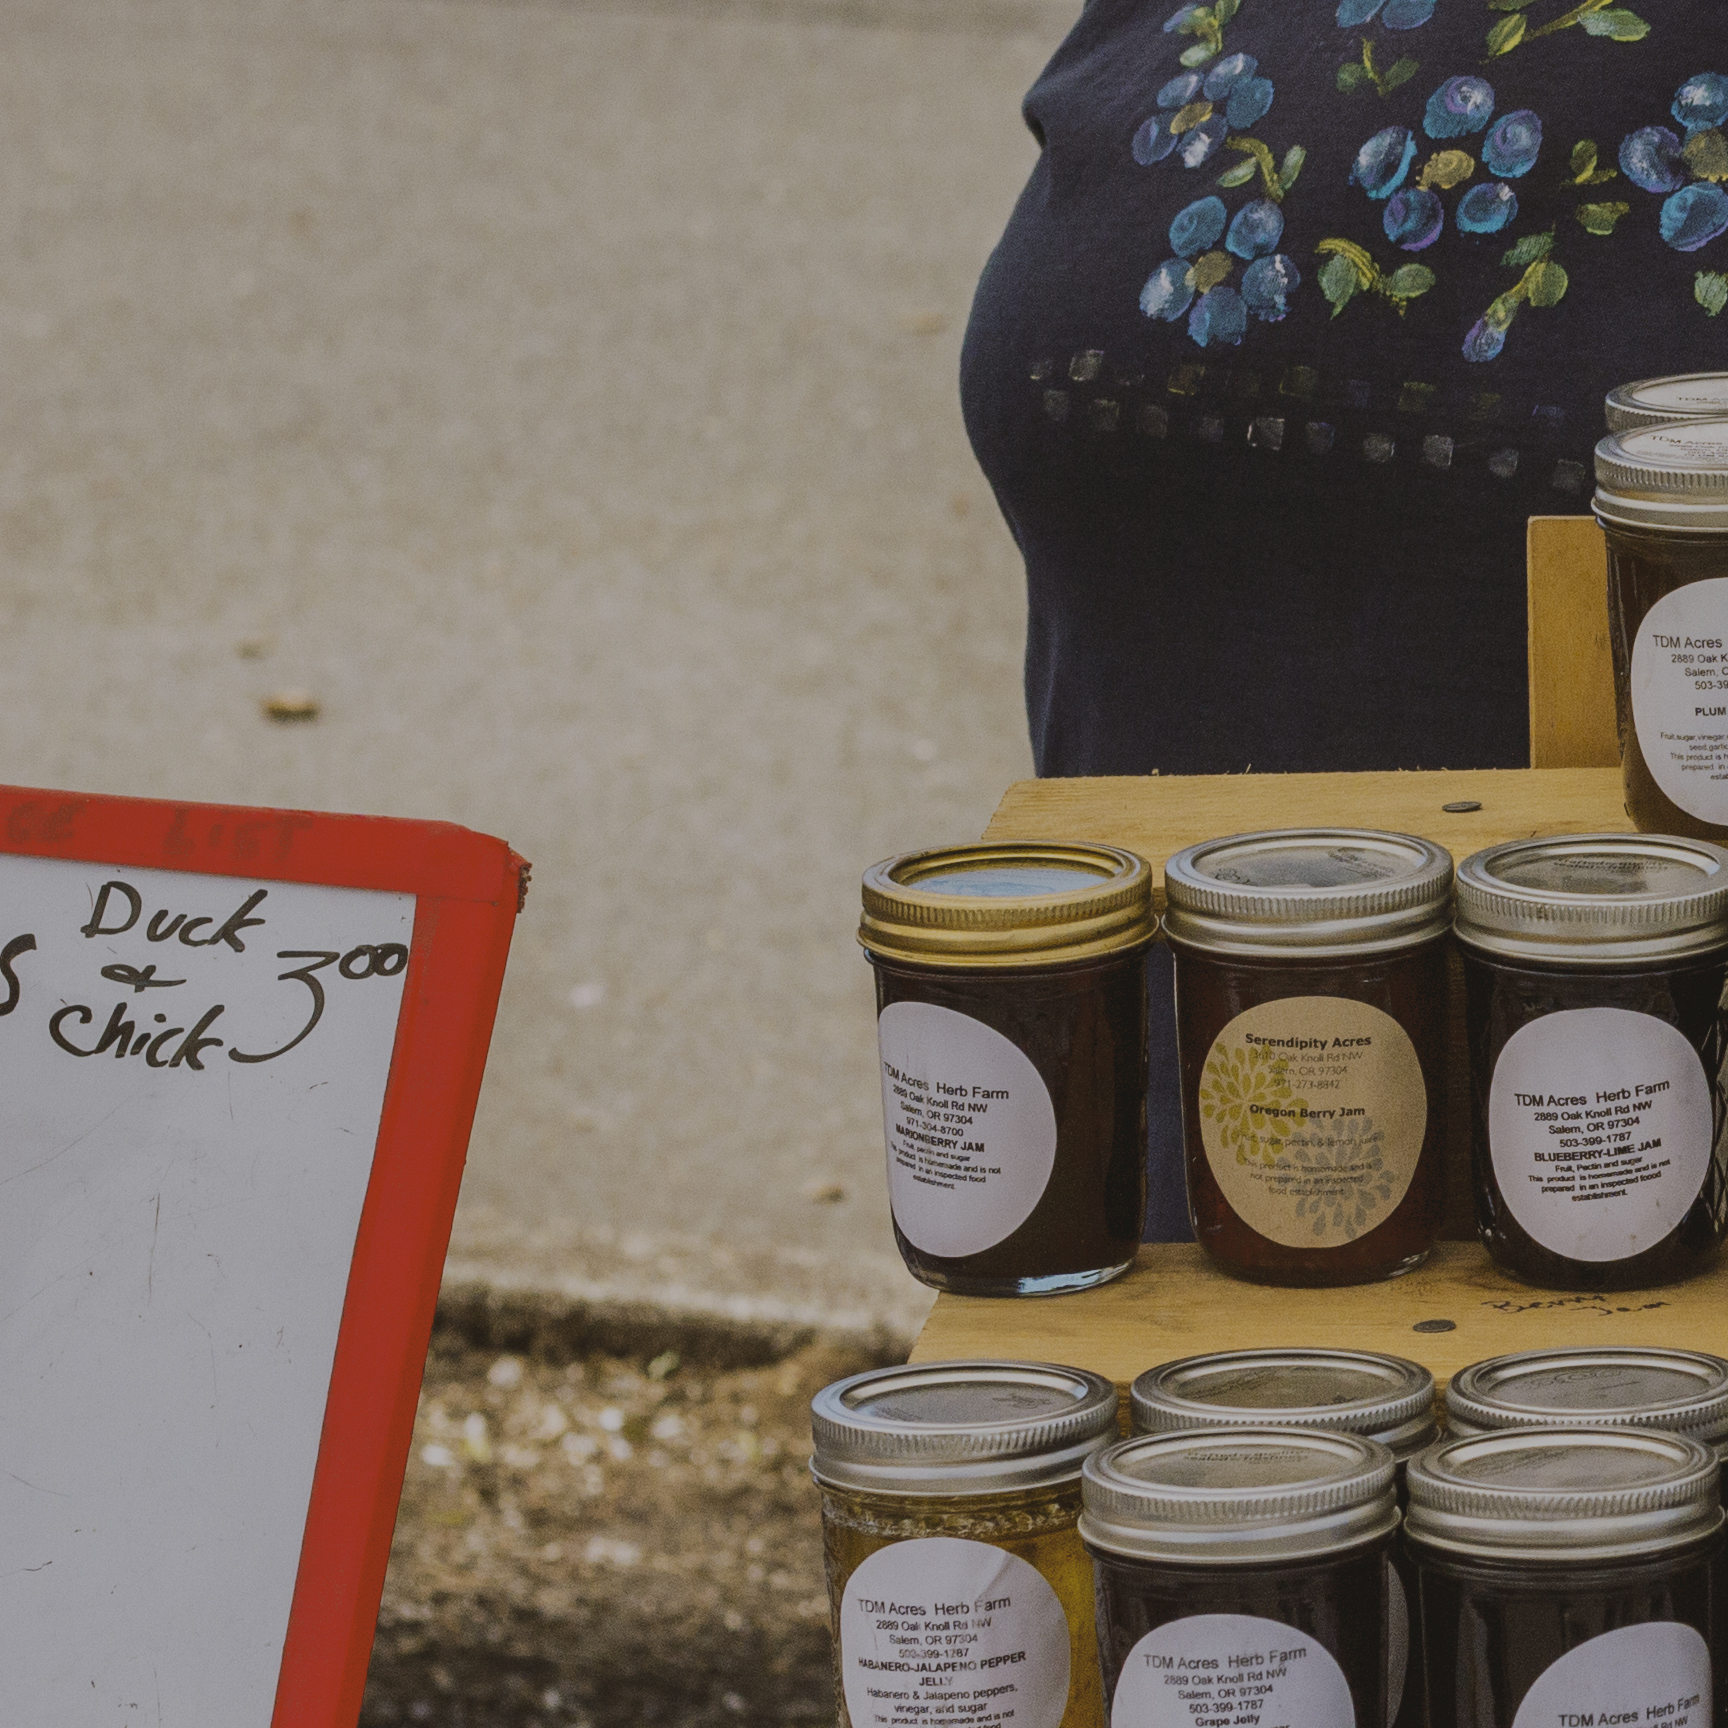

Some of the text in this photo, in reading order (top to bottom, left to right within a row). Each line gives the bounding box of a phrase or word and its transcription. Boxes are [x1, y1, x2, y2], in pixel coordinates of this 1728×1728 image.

[1652, 634, 1681, 649] TDM
[1684, 636, 1723, 649] Acres
[1695, 707, 1726, 716] PLUM
[80, 880, 269, 953] Duck
[1245, 1033, 1372, 1050] Serendipity Acres
[936, 1082, 1009, 1099] Herb Farm
[1249, 1104, 1366, 1119] Oregon Berry Jam
[960, 1141, 985, 1153] JAM
[1534, 1138, 1662, 1162] BLUEBERRY-LIME JAM
[980, 1651, 1026, 1669] PEPPER
[1558, 1694, 1700, 1727] TDM Acres Herb Farm
[1195, 1716, 1230, 1728] Grape
